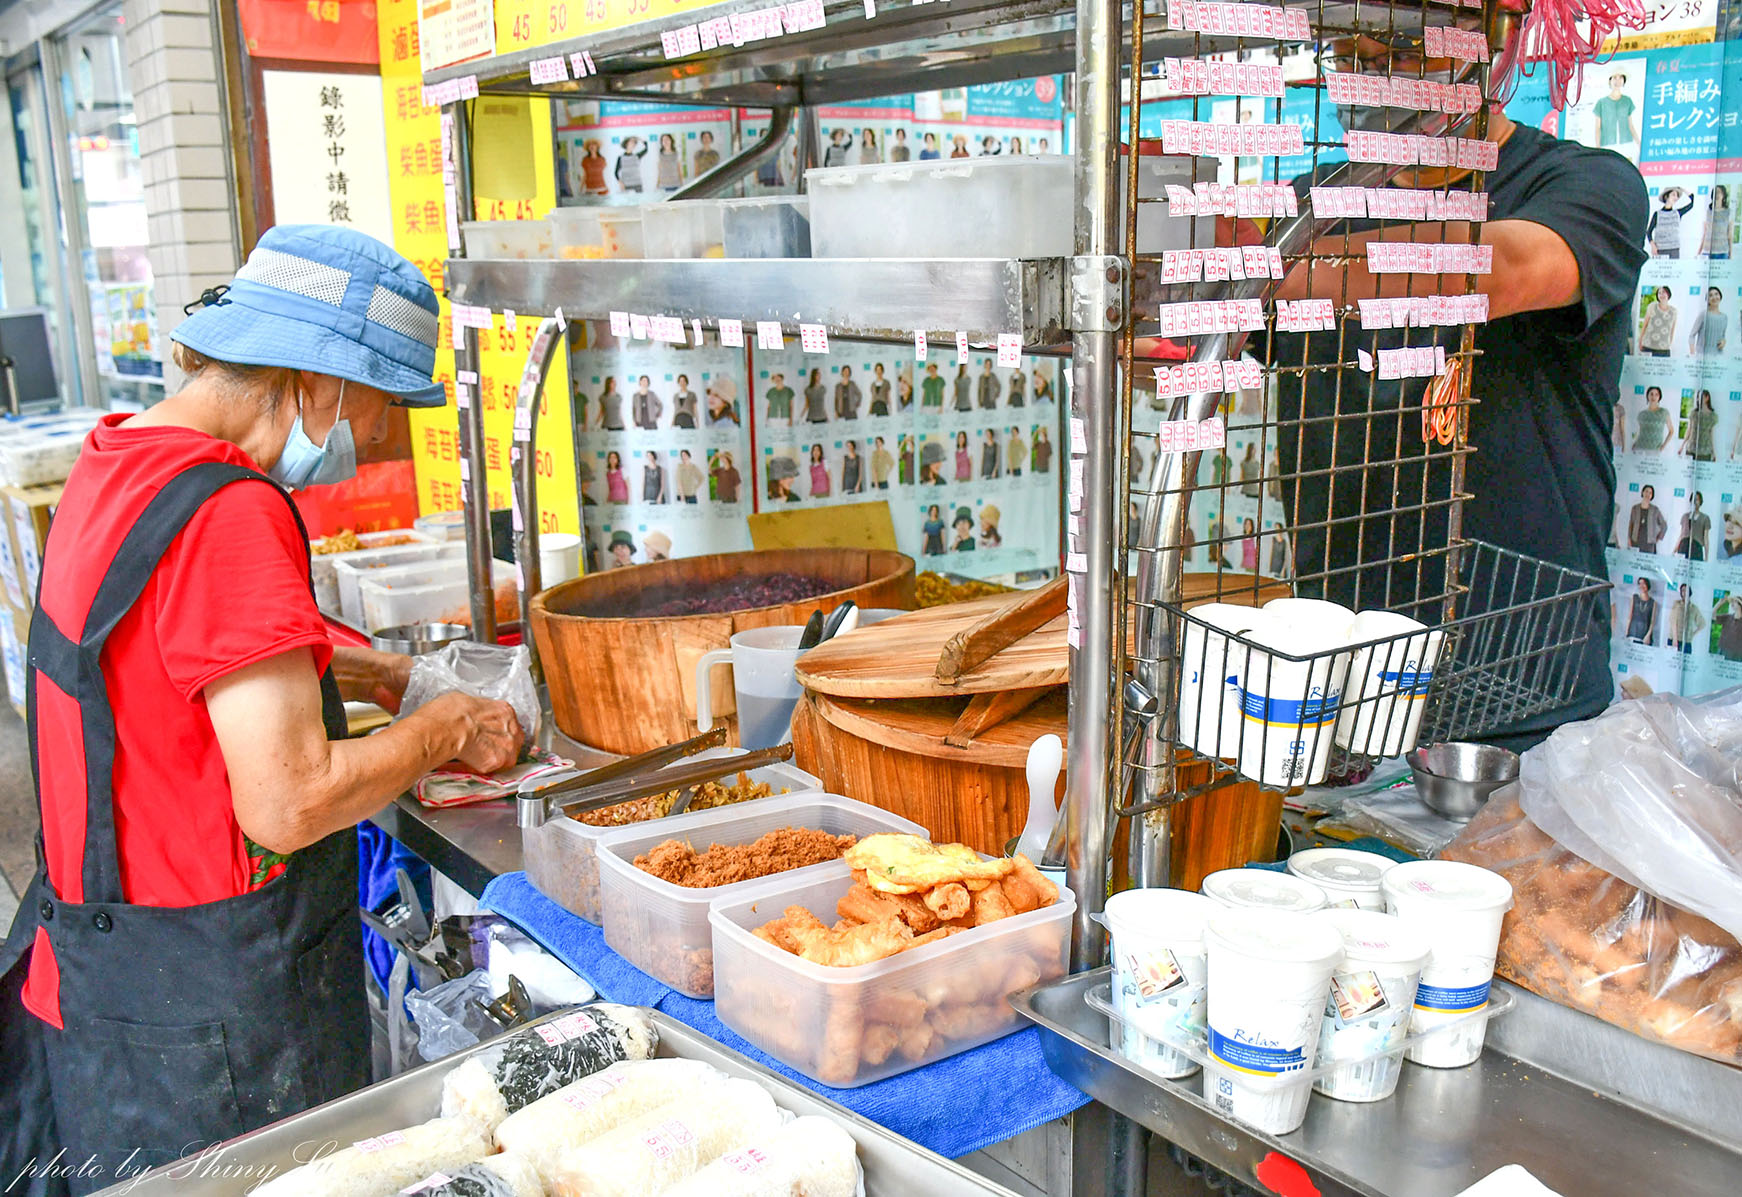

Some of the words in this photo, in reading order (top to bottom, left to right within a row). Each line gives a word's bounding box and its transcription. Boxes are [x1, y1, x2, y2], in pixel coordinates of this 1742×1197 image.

[1680, 1, 1702, 19] 38
[513, 14, 530, 42] 45
[550, 4, 566, 33] 50
[1650, 78, 1721, 107] 手編み
[1650, 107, 1742, 131] コレクショ
[319, 84, 353, 222] 錄影中請微
[405, 200, 447, 234] 柴魚
[1164, 254, 1176, 277] 55
[1207, 252, 1217, 275] 55
[1244, 253, 1255, 275] 55
[1256, 253, 1266, 275] 55
[1160, 371, 1170, 394] 50
[1172, 368, 1184, 392] 50
[1187, 366, 1197, 390] 50
[1197, 366, 1208, 390] 50
[1212, 364, 1222, 388] 50
[1310, 684, 1341, 699] Rlax
[1234, 1028, 1280, 1049] Relax
